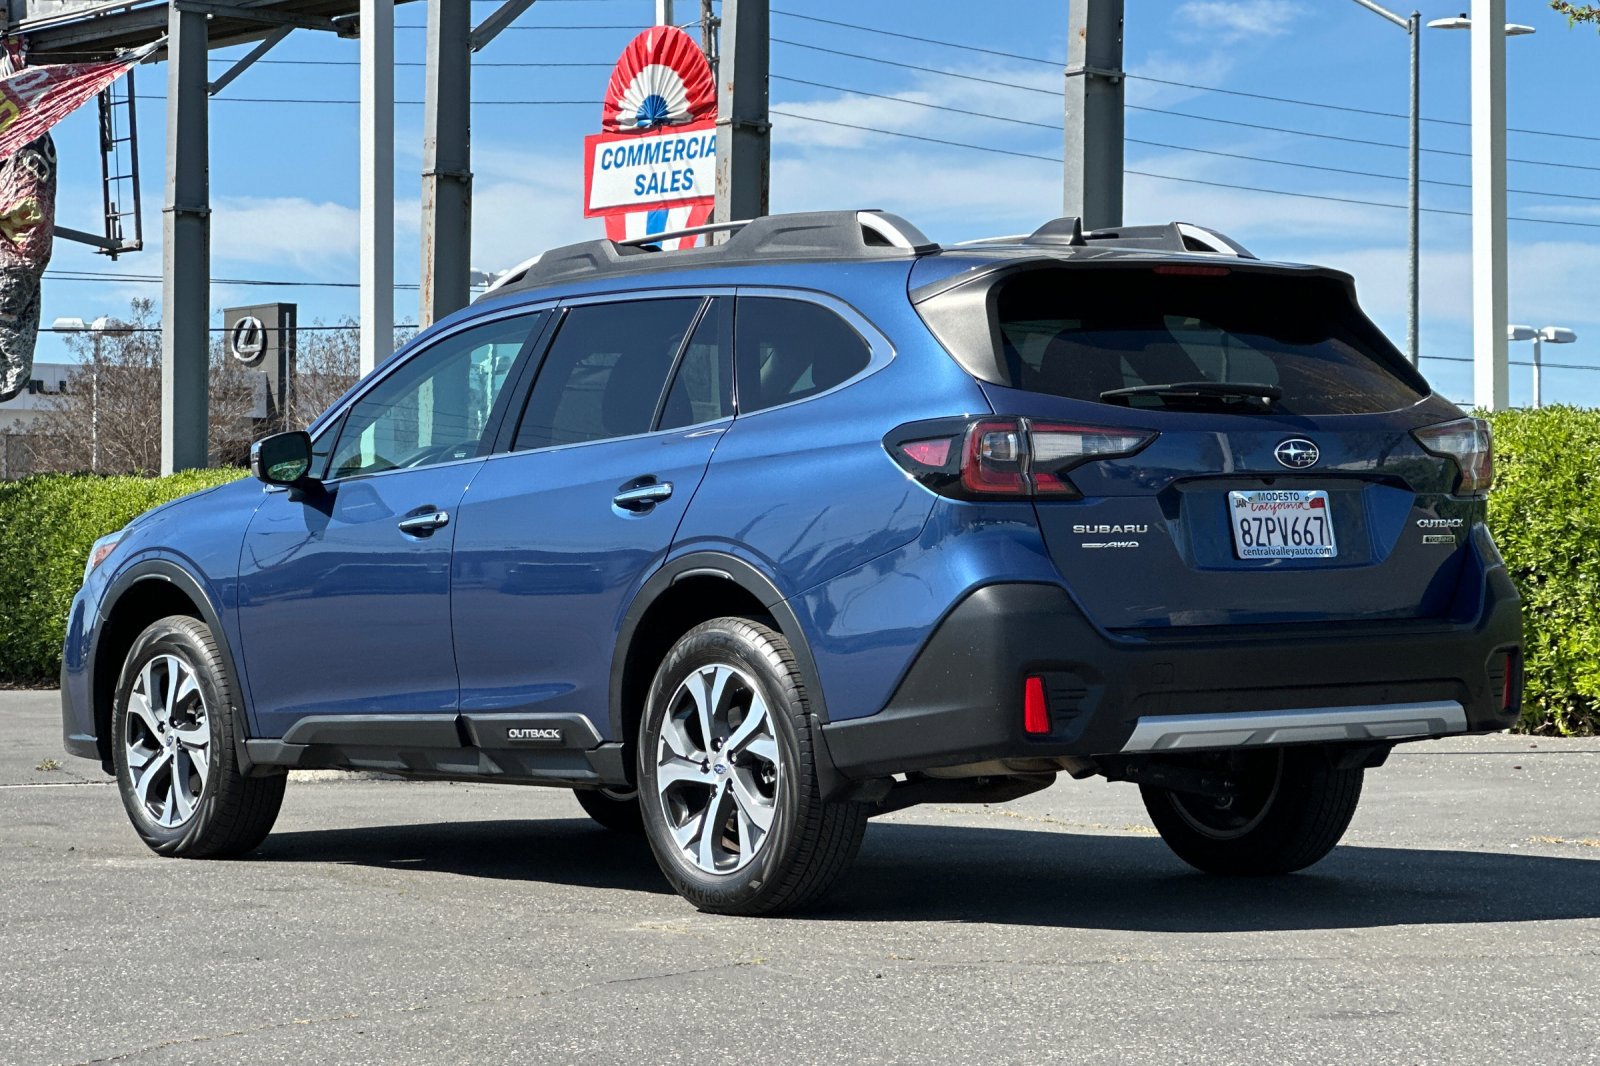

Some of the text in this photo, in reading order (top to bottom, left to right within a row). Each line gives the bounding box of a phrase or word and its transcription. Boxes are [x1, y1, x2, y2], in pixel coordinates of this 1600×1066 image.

[601, 134, 716, 171] COMMERCIA
[634, 167, 694, 196] SALES
[1257, 492, 1300, 502] MODESTO
[1416, 518, 1464, 528] OUTBACK
[1072, 524, 1149, 534] SUBARU
[1240, 516, 1324, 547] 8ZPV667
[1243, 546, 1333, 557] centralvalleyauto.com
[508, 728, 560, 739] OUTBACK
